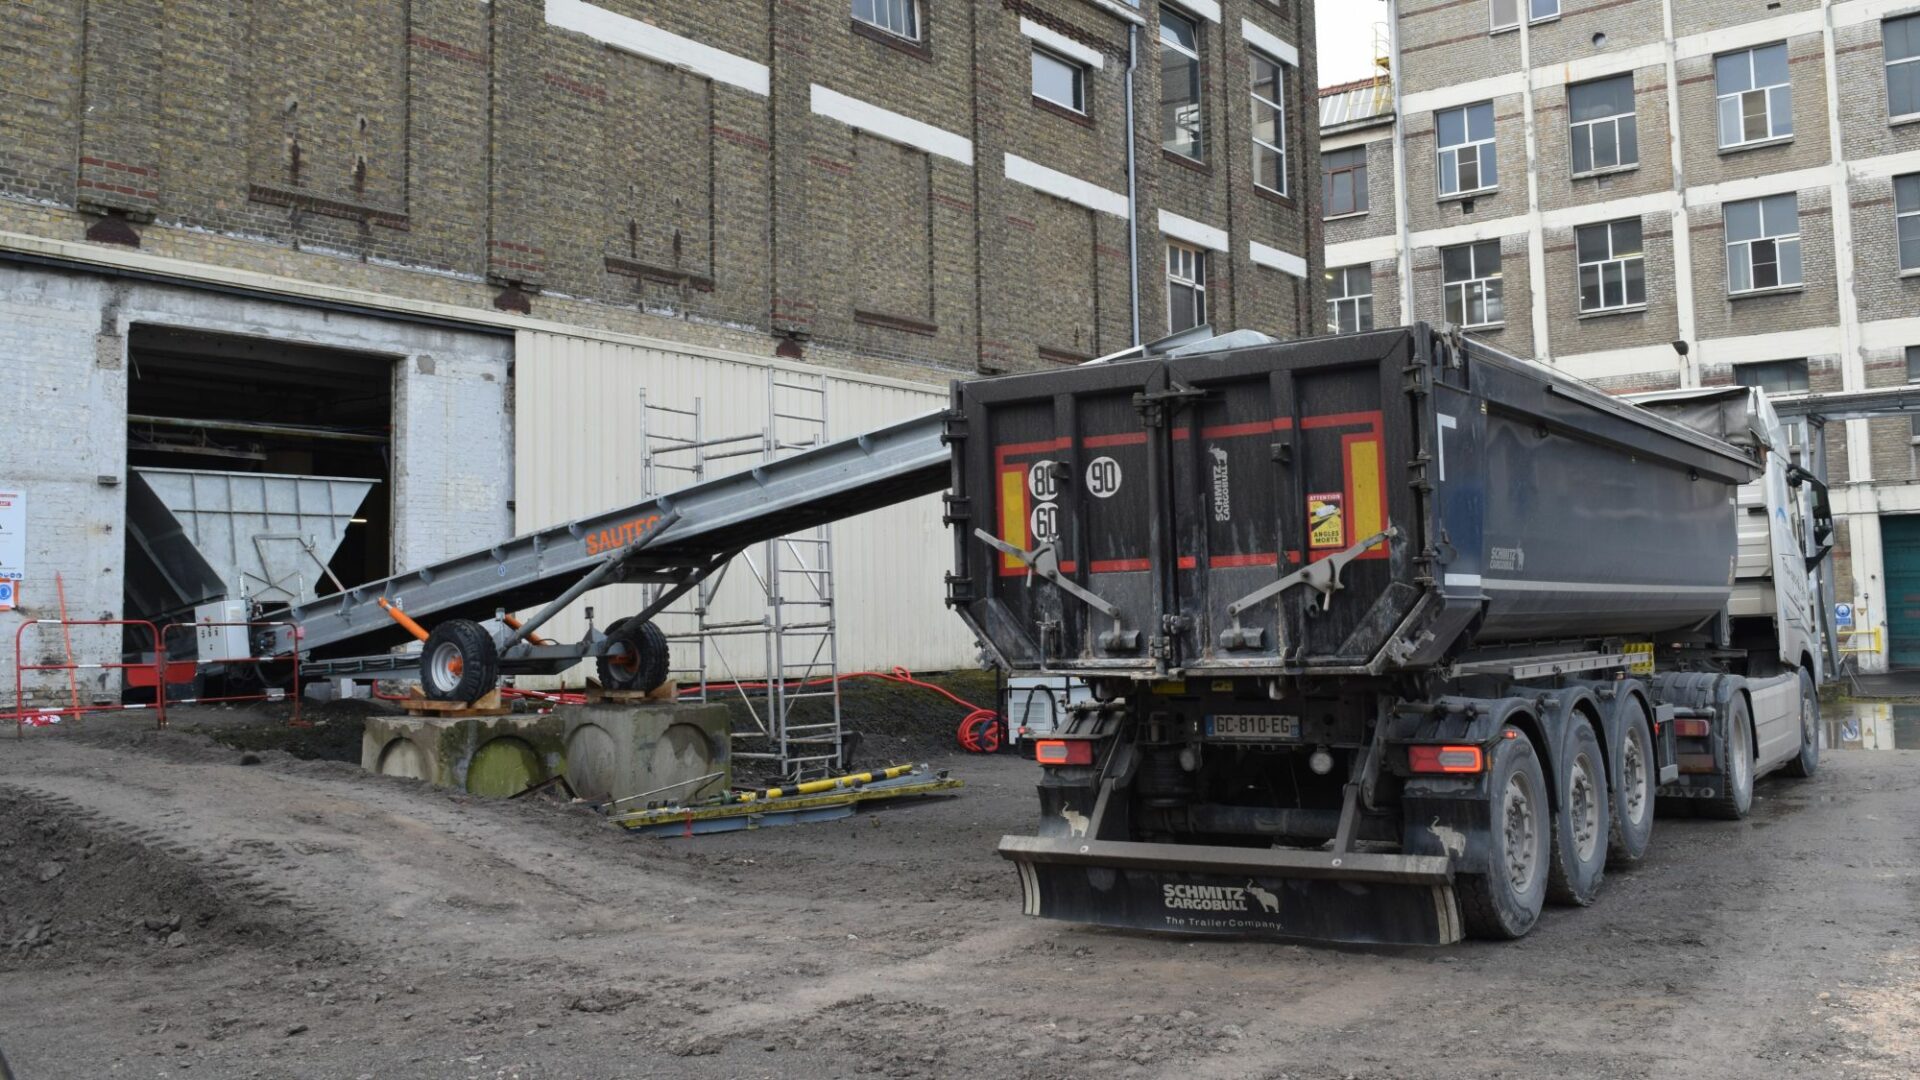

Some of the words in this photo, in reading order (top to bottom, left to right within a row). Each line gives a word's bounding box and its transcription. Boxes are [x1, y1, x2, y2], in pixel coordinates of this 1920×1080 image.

[1091, 461, 1116, 493] 90
[1213, 465, 1224, 521] SCHMITZ
[1221, 465, 1230, 521] CARGOBULL
[1313, 530, 1339, 538] ANGLES
[1216, 716, 1289, 733] GC-810-EG
[1655, 786, 1715, 798] OLVO
[1163, 884, 1245, 900] SCHMITZ
[1164, 898, 1247, 910] CARGOBULL
[1165, 916, 1185, 926] The
[1189, 918, 1227, 928] Trailer
